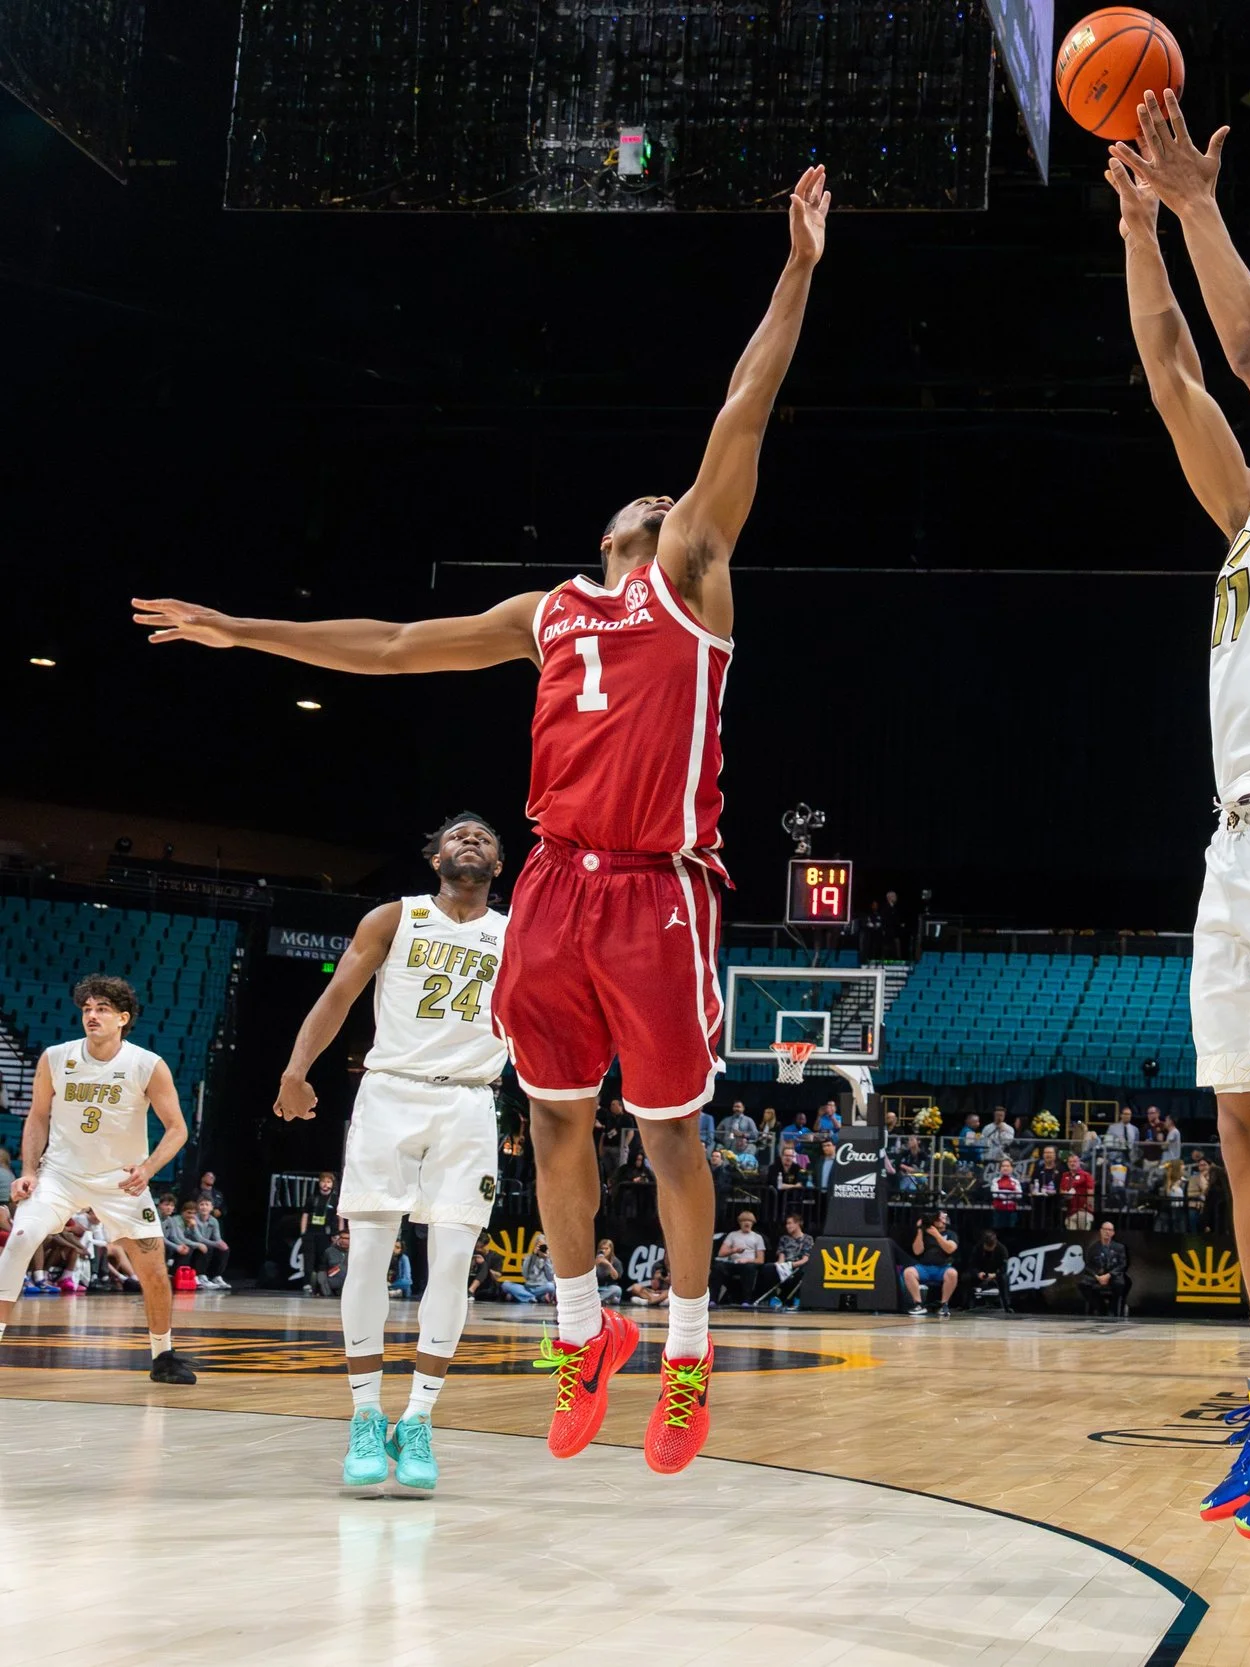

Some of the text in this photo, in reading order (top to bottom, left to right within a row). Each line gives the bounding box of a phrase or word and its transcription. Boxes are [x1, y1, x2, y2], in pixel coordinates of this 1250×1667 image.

[1212, 566, 1250, 649] 11
[543, 608, 653, 642] OKLAHOMA
[575, 635, 608, 712] 1
[807, 867, 846, 886] 8:11
[812, 886, 839, 915] 19
[281, 931, 325, 948] MGM
[407, 938, 499, 982] BUFFS
[416, 974, 482, 1022] 24
[64, 1082, 123, 1104] BUFFS
[80, 1106, 102, 1134] 3
[836, 1142, 879, 1166] Circa
[834, 1184, 876, 1192] MERCURY
[834, 1191, 876, 1199] INSURANCE
